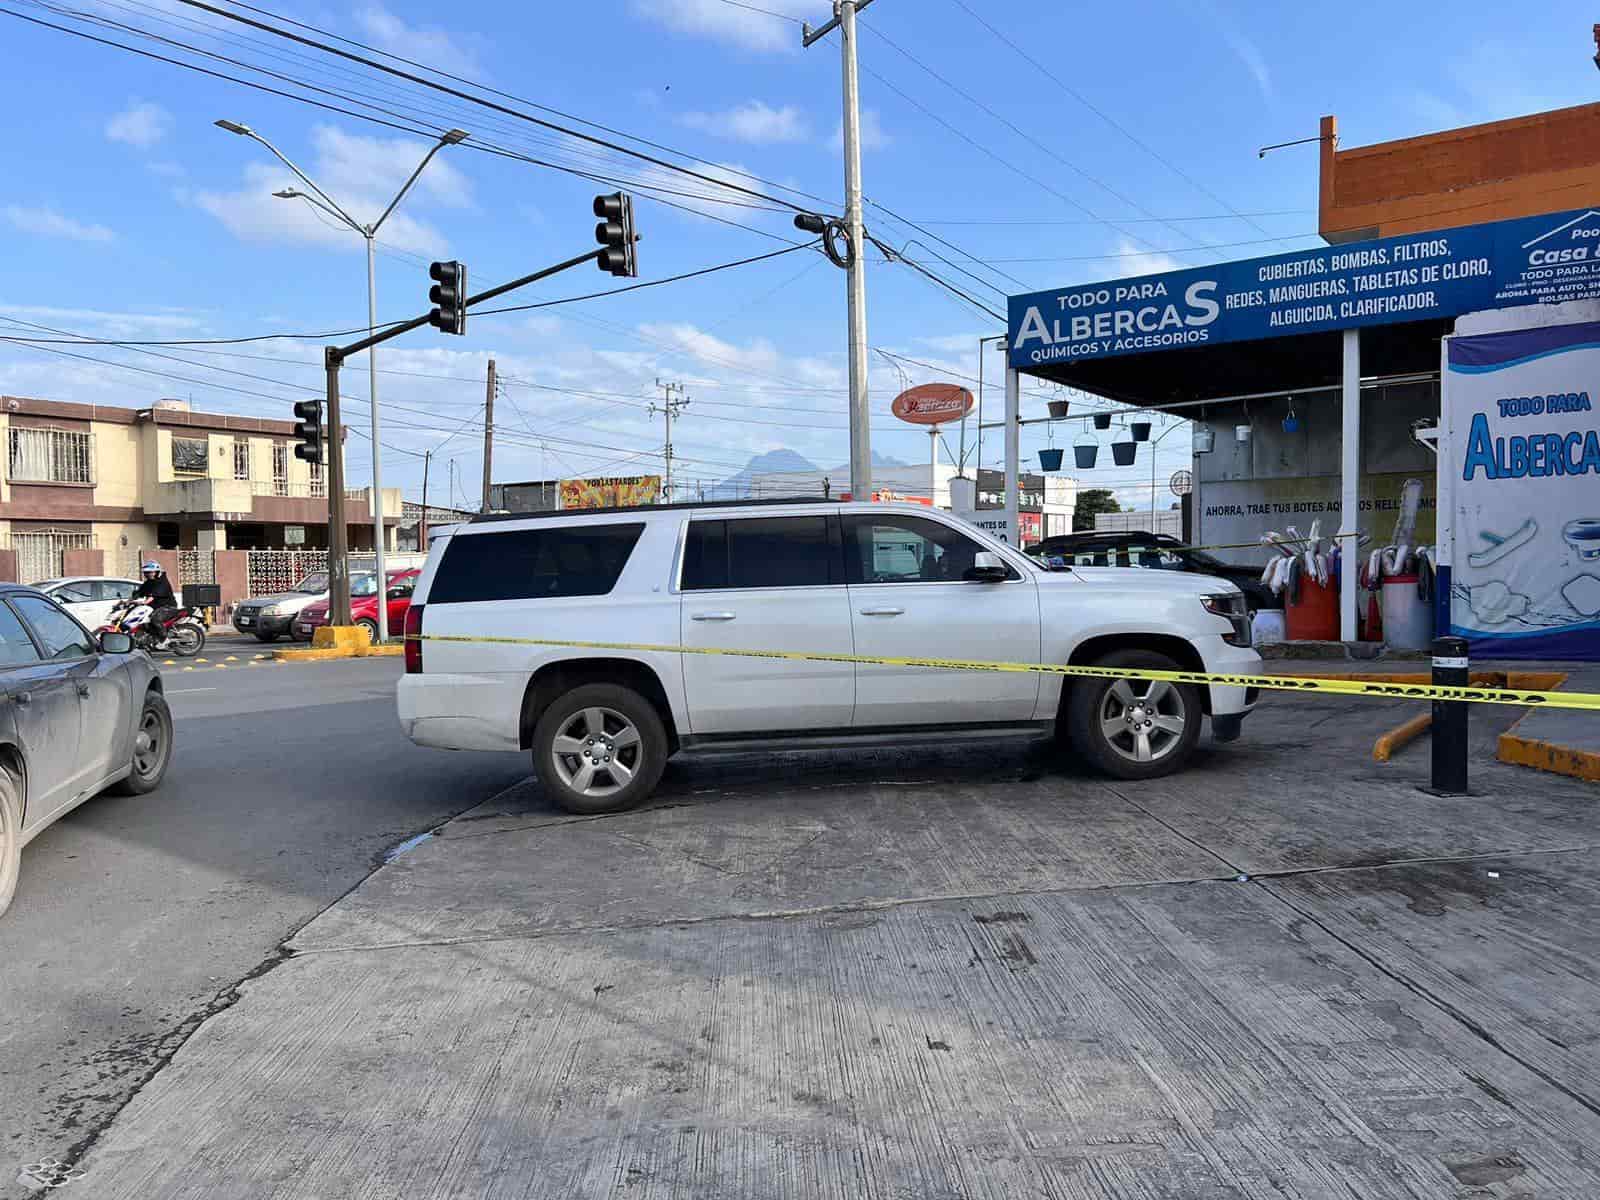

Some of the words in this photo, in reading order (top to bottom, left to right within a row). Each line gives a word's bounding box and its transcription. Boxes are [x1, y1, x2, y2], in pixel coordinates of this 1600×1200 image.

[1258, 258, 1328, 282] CUBIERTAS,
[1331, 248, 1390, 272] BOMBAS,
[1393, 239, 1452, 263] FILTROS,
[1528, 247, 1588, 265] Casa
[1225, 290, 1267, 310] REDES,
[1268, 278, 1350, 305] MANGUERAS,
[1352, 269, 1418, 293] TABLETAS
[1421, 266, 1439, 282] DE
[1442, 258, 1492, 280] CLORO,
[1520, 269, 1553, 280] TODO
[1556, 265, 1588, 276] PARA
[1056, 290, 1110, 311] TODO
[1115, 282, 1168, 302] PARA
[1269, 310, 1337, 328] ALGUICIDA,
[1340, 291, 1439, 319] CLARIFICADOR.
[1014, 280, 1220, 349] ALBERCAS
[1031, 341, 1099, 362] QUÍMICOS
[1103, 341, 1111, 351] Y
[1114, 329, 1209, 350] ACCESORIOS
[1497, 396, 1545, 418] TODO
[1546, 391, 1592, 413] PARA
[1206, 504, 1245, 517] AHORRA,
[1247, 503, 1271, 514] TRAE
[1273, 502, 1291, 513] TUS
[1293, 501, 1325, 513] BOTES
